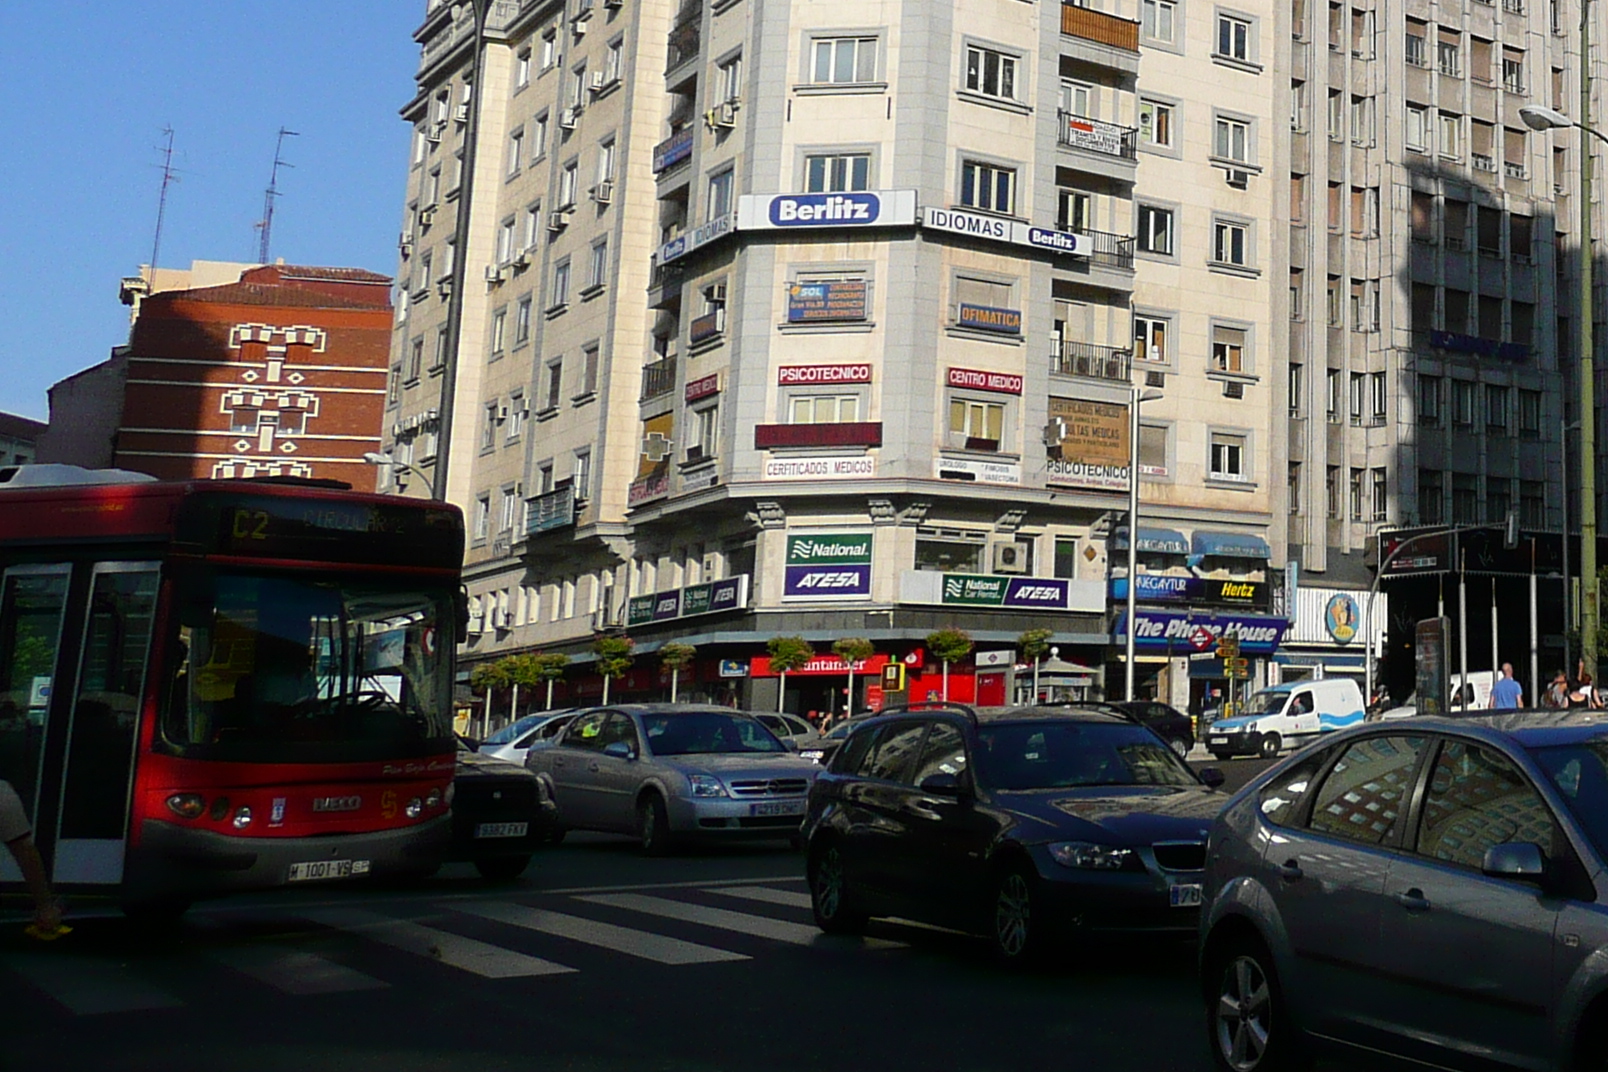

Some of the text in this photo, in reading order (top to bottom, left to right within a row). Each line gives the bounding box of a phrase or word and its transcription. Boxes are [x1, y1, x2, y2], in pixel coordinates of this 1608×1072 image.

[779, 195, 869, 221] Berlitz
[931, 210, 1004, 237] IDIOMAS
[1032, 230, 1073, 248] Berlitz
[962, 306, 1020, 327] OFIMATICA
[779, 366, 869, 381] PSICOTECNICO
[949, 369, 1021, 390] CENTRO MEDICO
[834, 461, 872, 474] MEDICOS
[1047, 460, 1131, 480] PSICOTECNICO
[232, 509, 270, 540] C2
[811, 543, 866, 557] National
[796, 572, 859, 588] ATESA
[966, 579, 1001, 591] National
[1014, 586, 1060, 601] ATESA
[1221, 583, 1255, 597] Hertz
[1133, 618, 1164, 638] The
[1224, 621, 1278, 642] House
[800, 659, 867, 672] antander
[313, 794, 363, 812] IVECO
